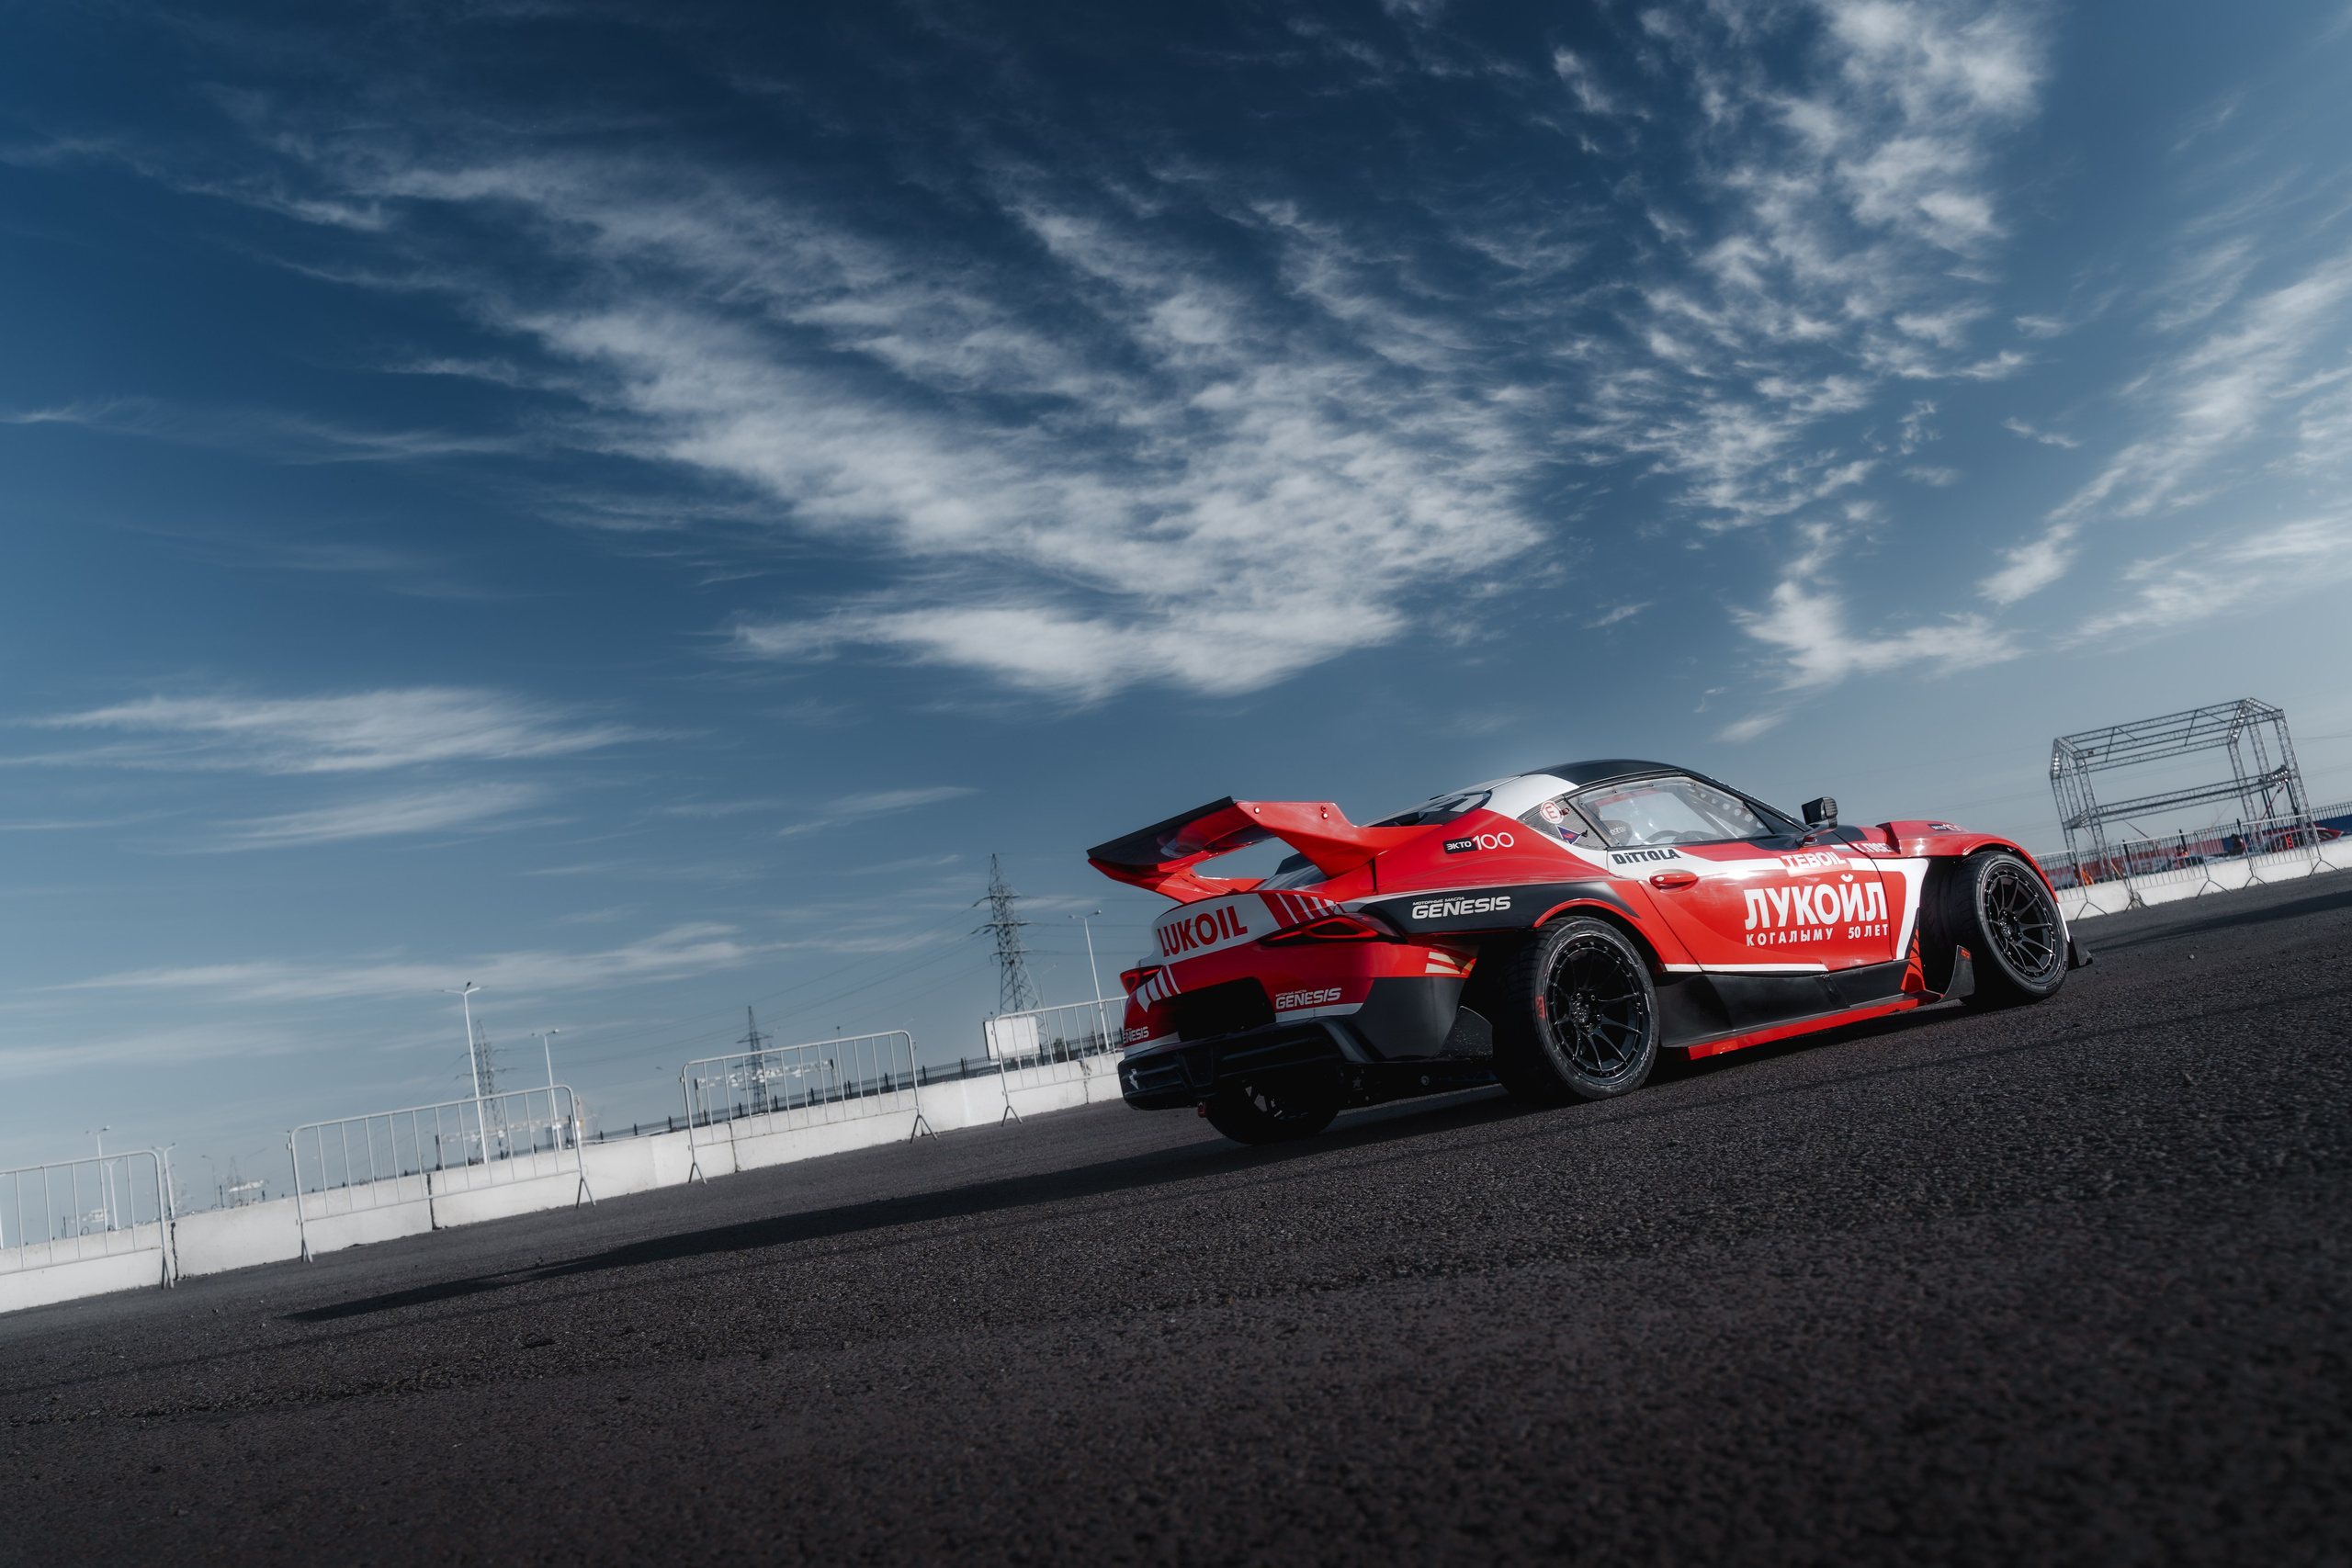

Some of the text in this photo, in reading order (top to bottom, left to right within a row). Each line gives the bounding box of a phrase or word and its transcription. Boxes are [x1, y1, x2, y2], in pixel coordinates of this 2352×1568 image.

[1446, 831, 1514, 851] ЭКТО 100
[1781, 851, 1847, 869] TEBOIL
[1412, 896, 1511, 919] GENESIS
[1744, 874, 1887, 931] ЛУКОЙЛ
[1158, 905, 1248, 957] LUKOIL
[1746, 924, 1888, 946] КОГАЛЫМУ 50 ЛЕТ
[1275, 987, 1341, 1010] GENESIS
[1123, 1026, 1149, 1043] ENESIS
